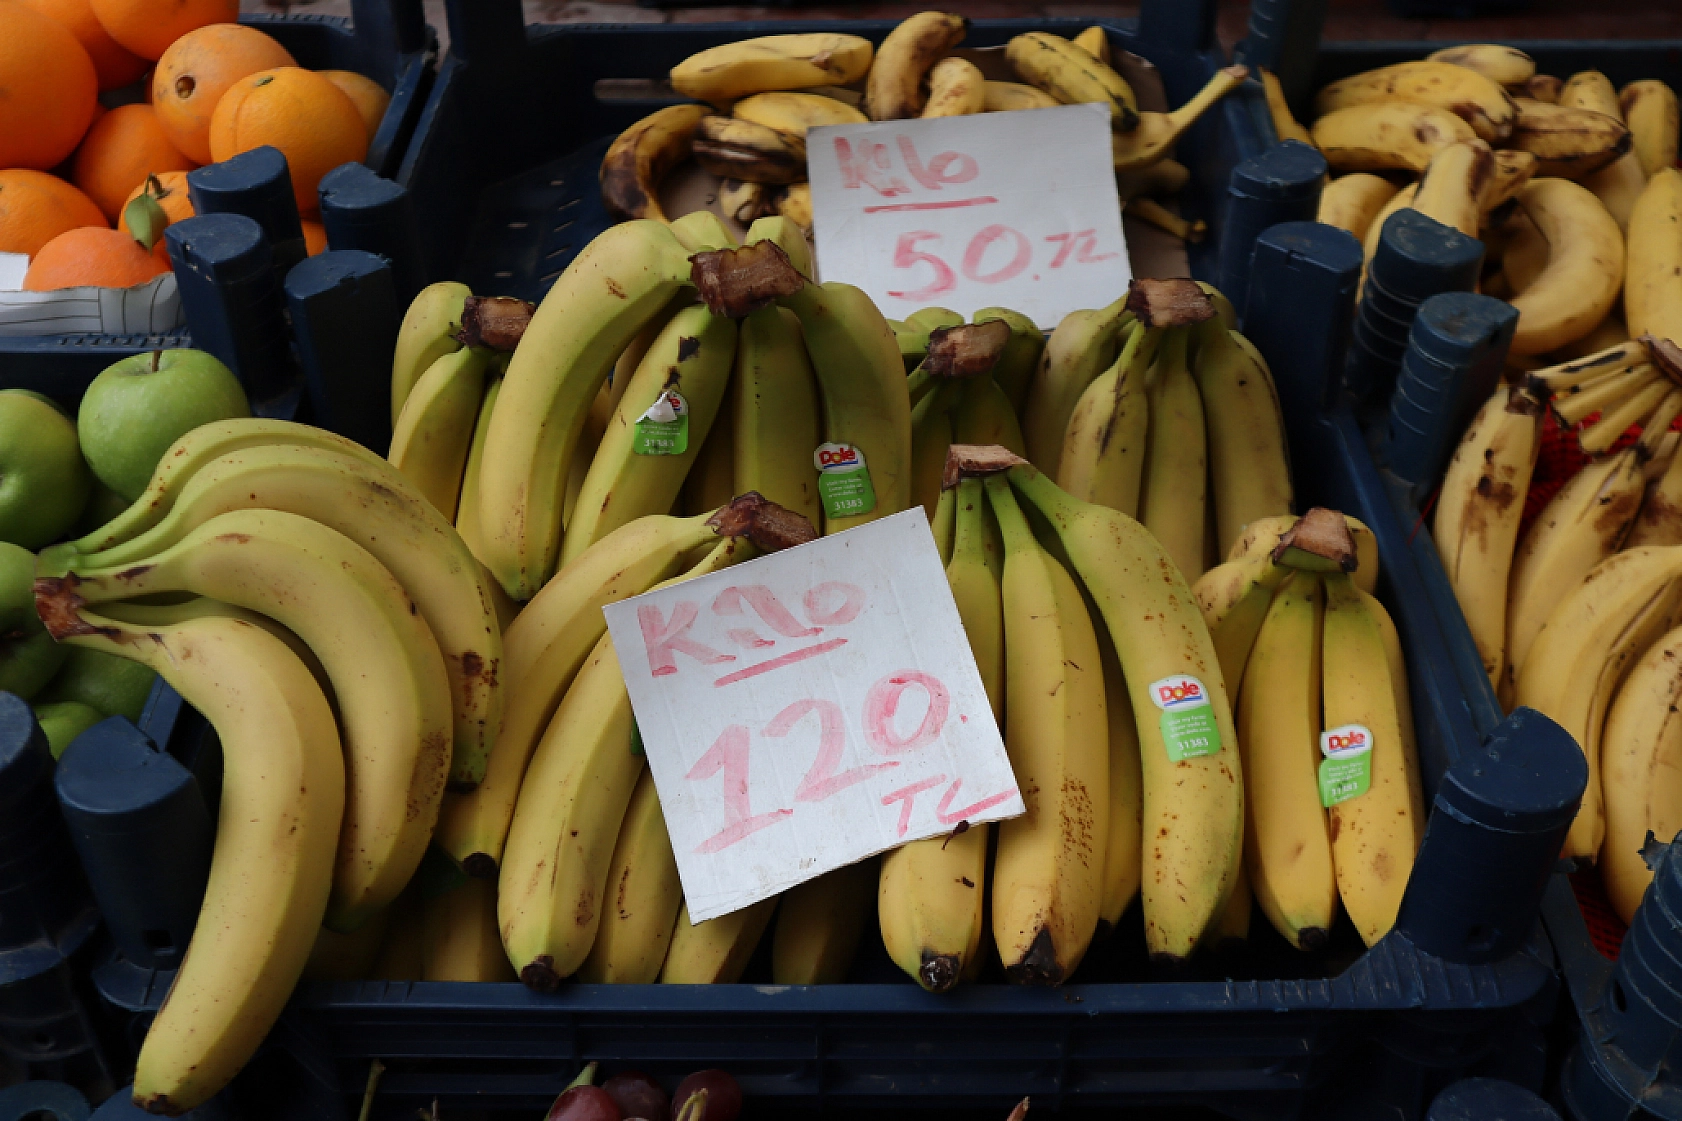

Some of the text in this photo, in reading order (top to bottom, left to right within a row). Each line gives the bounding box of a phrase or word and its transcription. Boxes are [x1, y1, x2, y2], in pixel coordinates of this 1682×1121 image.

[819, 447, 856, 464] Dole
[834, 498, 864, 511] 31383
[1159, 680, 1200, 703] Dole
[1177, 736, 1209, 750] 31383
[1328, 730, 1366, 751] Dole
